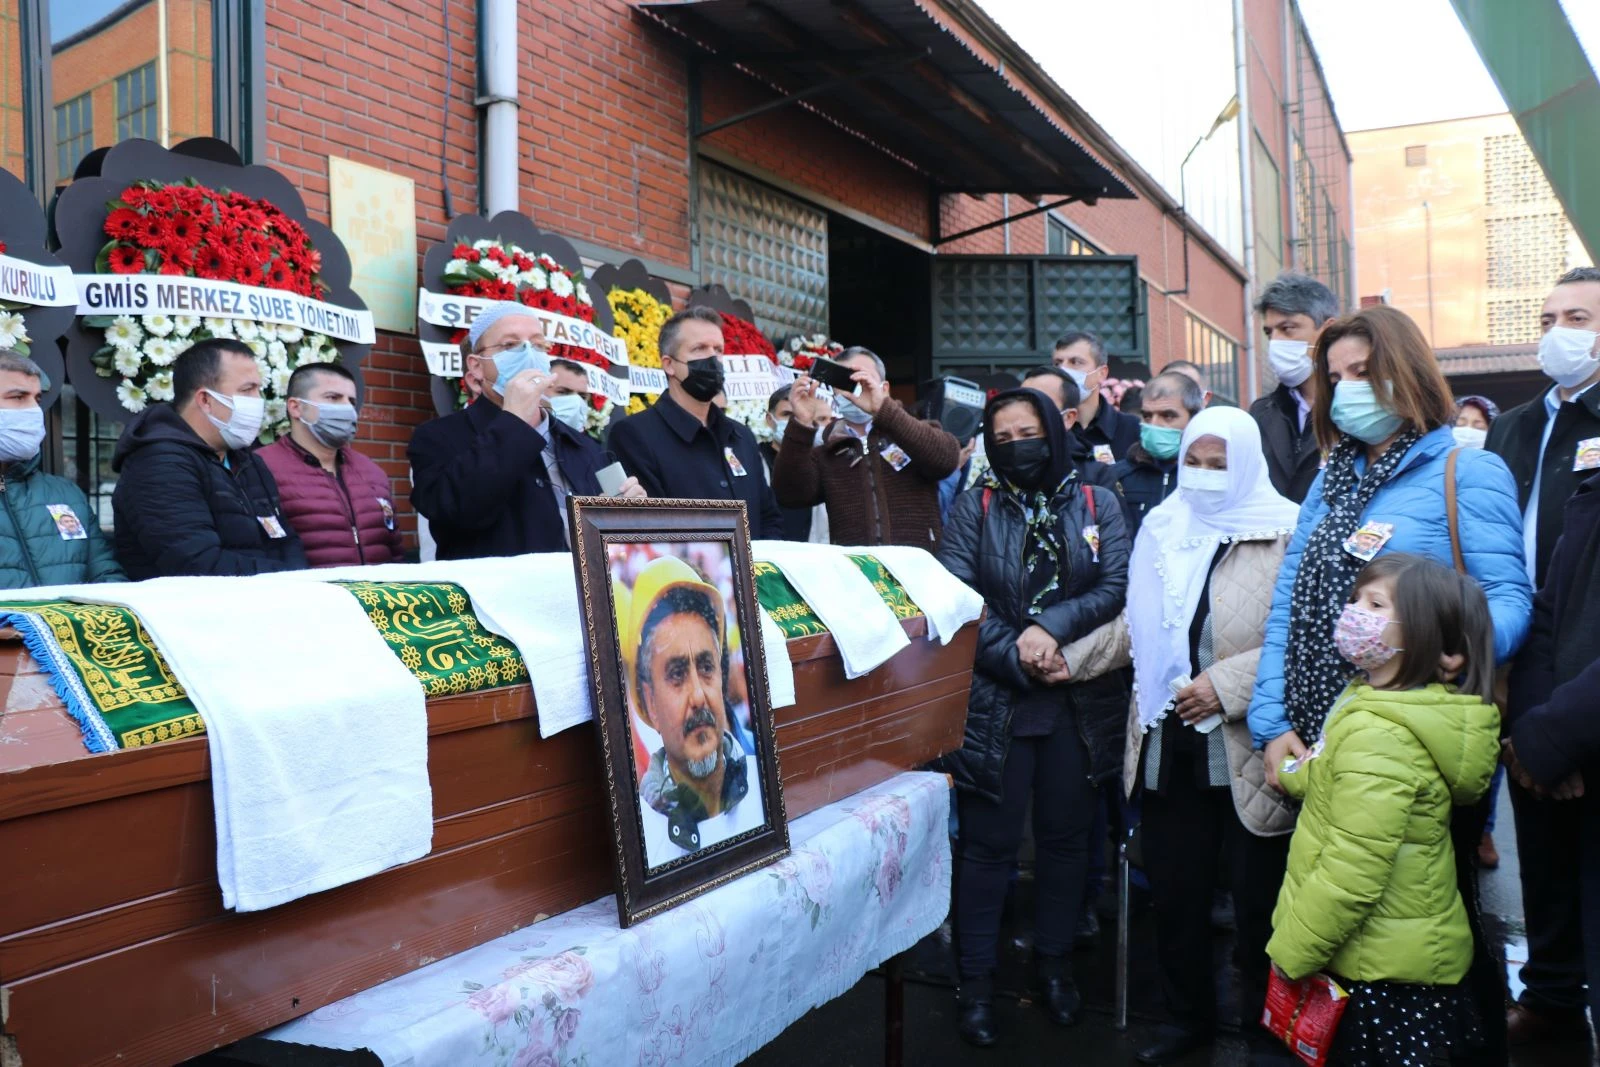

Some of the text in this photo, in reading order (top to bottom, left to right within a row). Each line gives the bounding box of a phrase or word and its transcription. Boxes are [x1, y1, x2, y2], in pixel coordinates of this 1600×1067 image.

[1, 264, 57, 301] KURULU
[85, 277, 361, 339] GMİS MERKEZ ŞUBE YÖNETİMİ
[441, 302, 484, 327] ŞE
